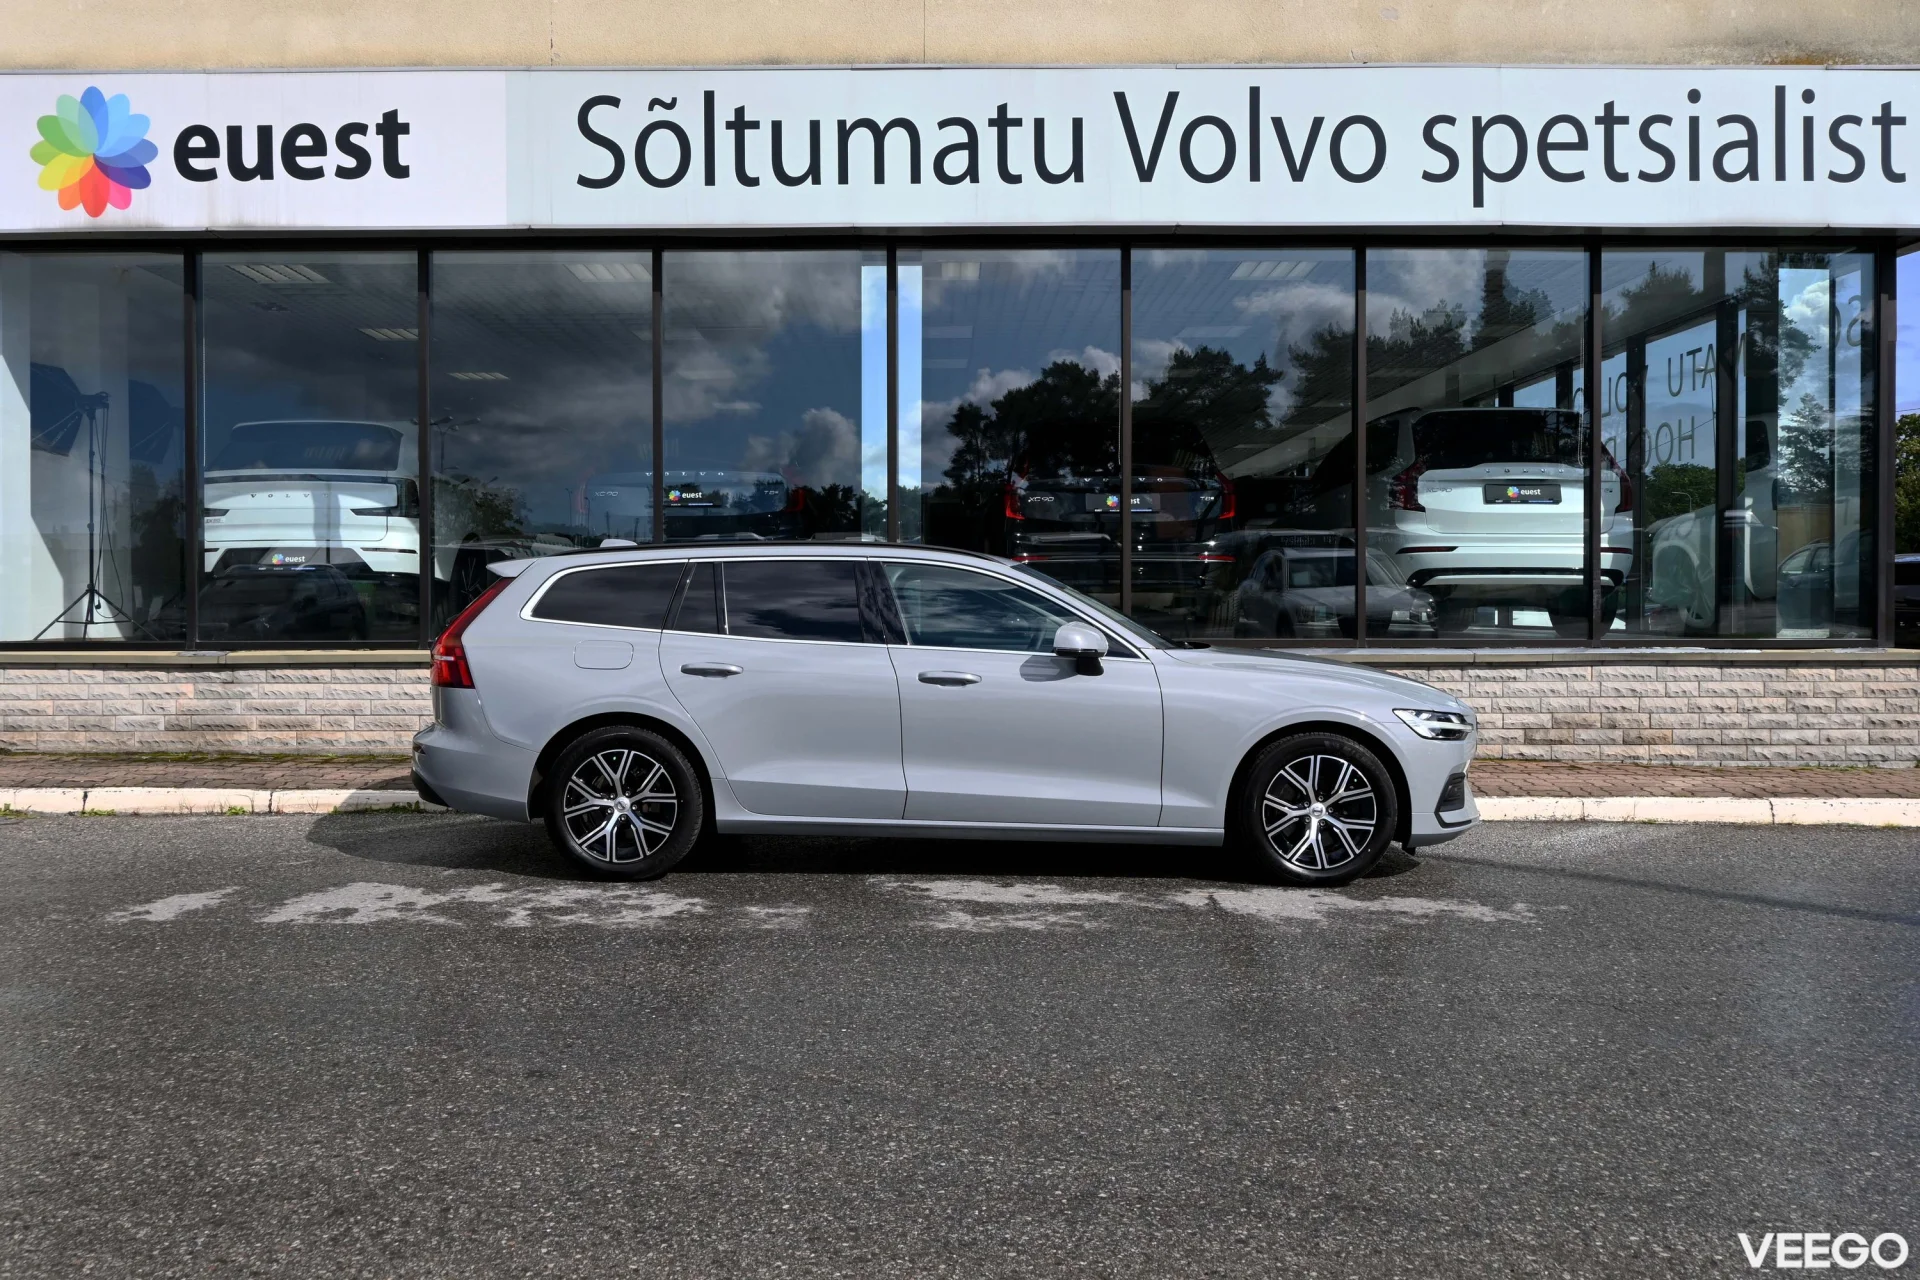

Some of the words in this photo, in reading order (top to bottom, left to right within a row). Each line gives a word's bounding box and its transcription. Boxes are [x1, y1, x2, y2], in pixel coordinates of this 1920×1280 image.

[173, 108, 411, 182] euest
[576, 90, 1085, 190] Sõltumatu
[1112, 85, 1387, 184] Volvo
[1421, 85, 1907, 208] spetsialist
[681, 491, 703, 499] euest
[1520, 488, 1542, 496] euest
[284, 555, 306, 563] euest
